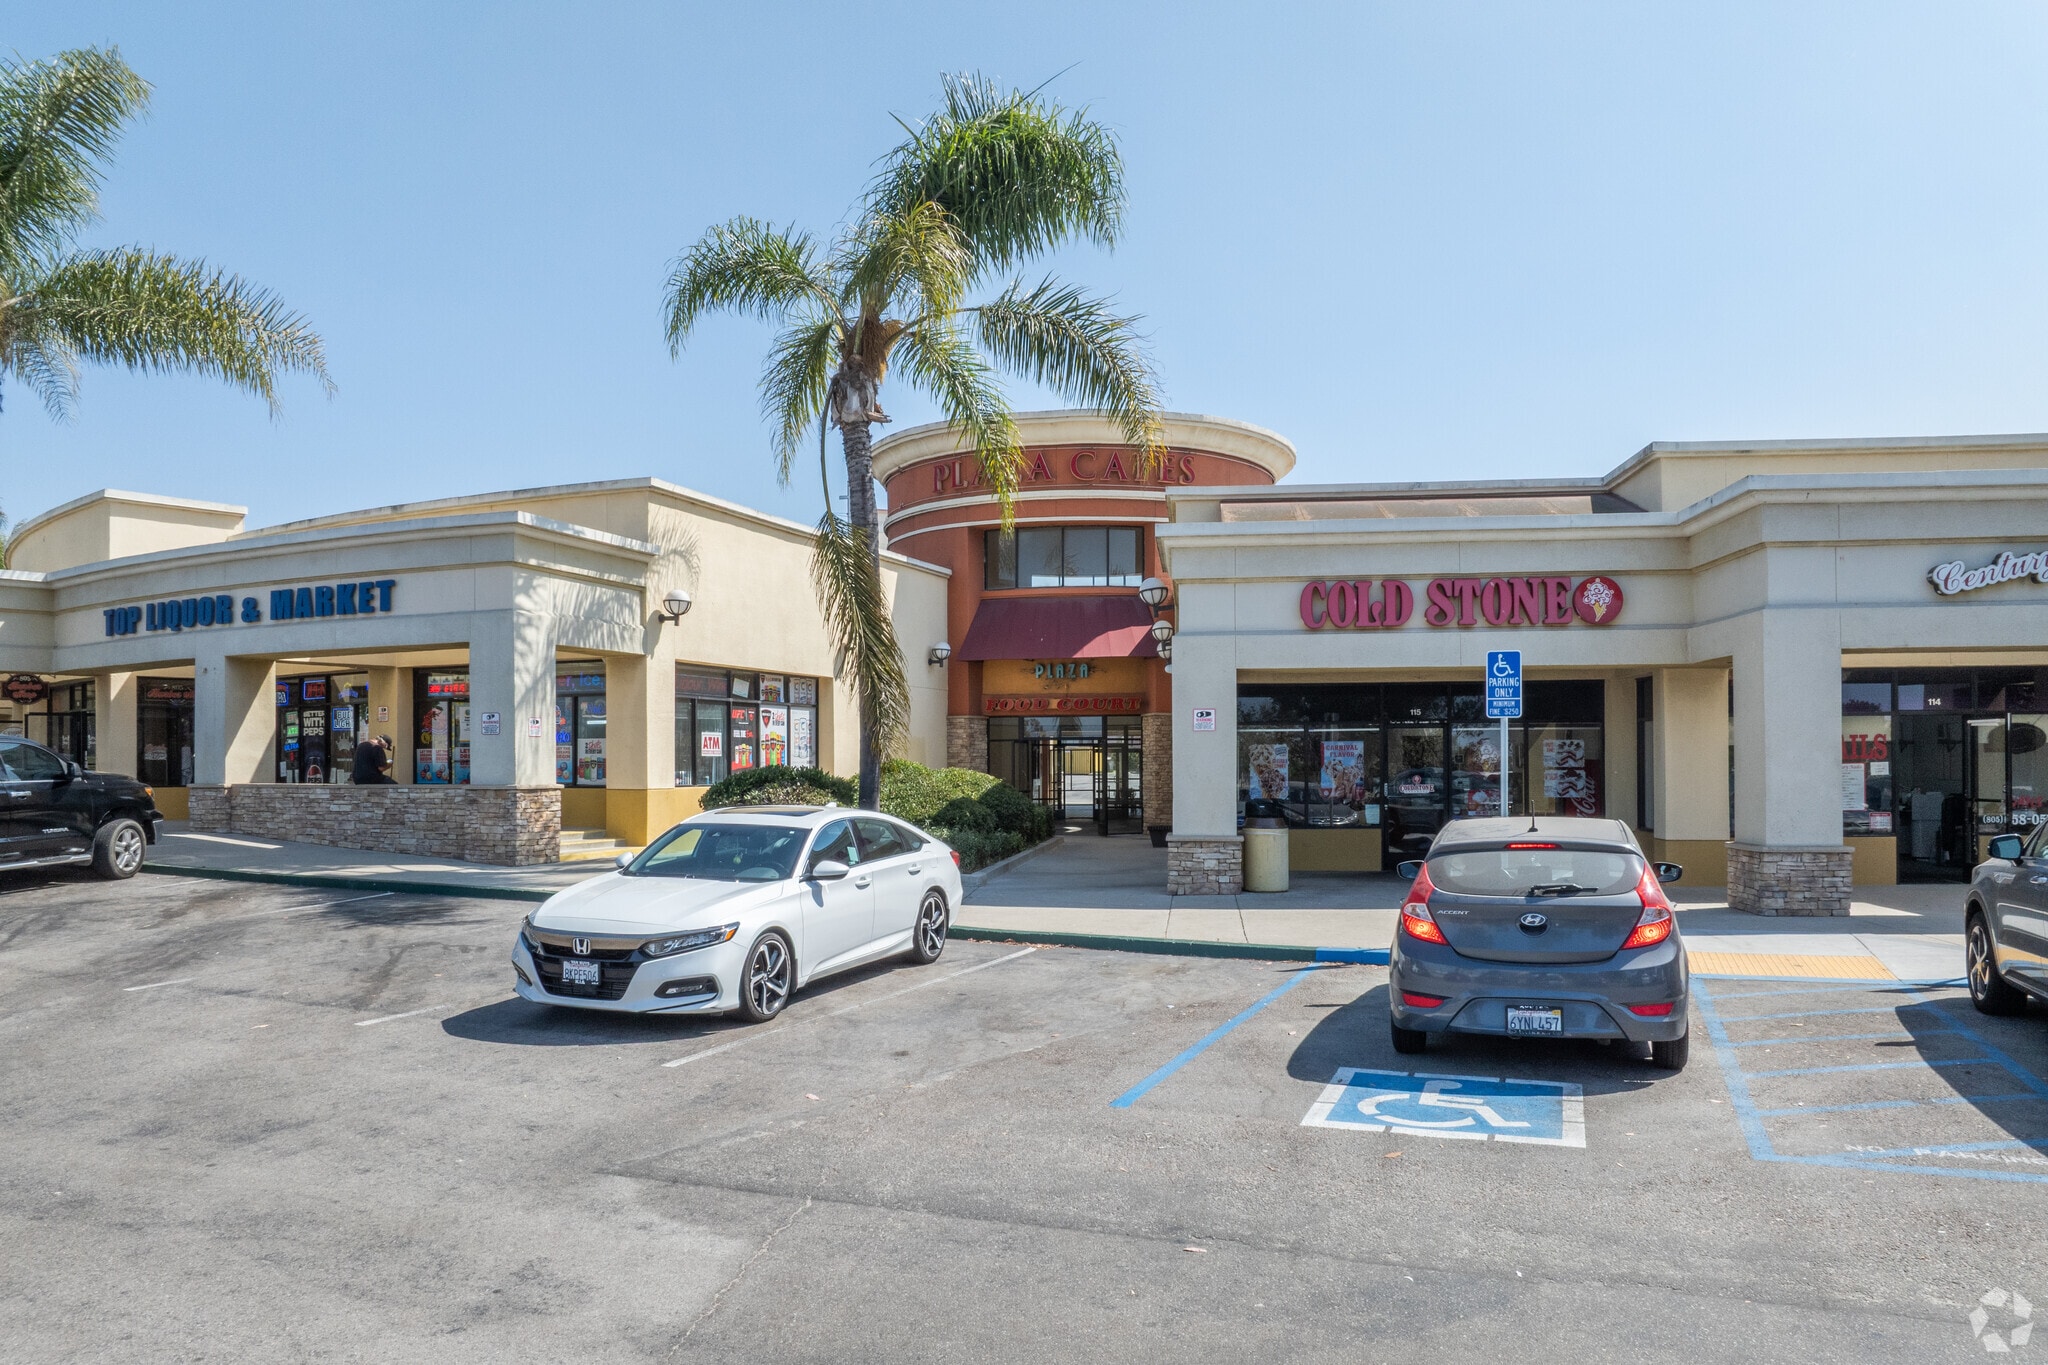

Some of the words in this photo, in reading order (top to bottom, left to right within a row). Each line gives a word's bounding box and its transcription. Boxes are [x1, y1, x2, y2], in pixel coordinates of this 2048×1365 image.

[934, 452, 1053, 492] PLA
[103, 606, 142, 637] TOP
[146, 595, 234, 632] LIQUOR
[241, 597, 261, 623] &
[270, 579, 396, 620] MARKET
[1300, 580, 1414, 629] COLD
[1424, 577, 1573, 626] STONE
[1035, 663, 1089, 679] PLAZA
[1489, 677, 1520, 687] PARKING
[1495, 688, 1514, 698] ONLY
[986, 698, 1049, 711] FOOD
[1056, 698, 1142, 711] COURT
[1928, 698, 1941, 706] 114
[732, 709, 745, 719] UFC
[303, 718, 325, 727] WITH
[334, 719, 351, 728] LIGH
[702, 736, 720, 750] ATM
[1510, 1016, 1559, 1030] 6YNL457
